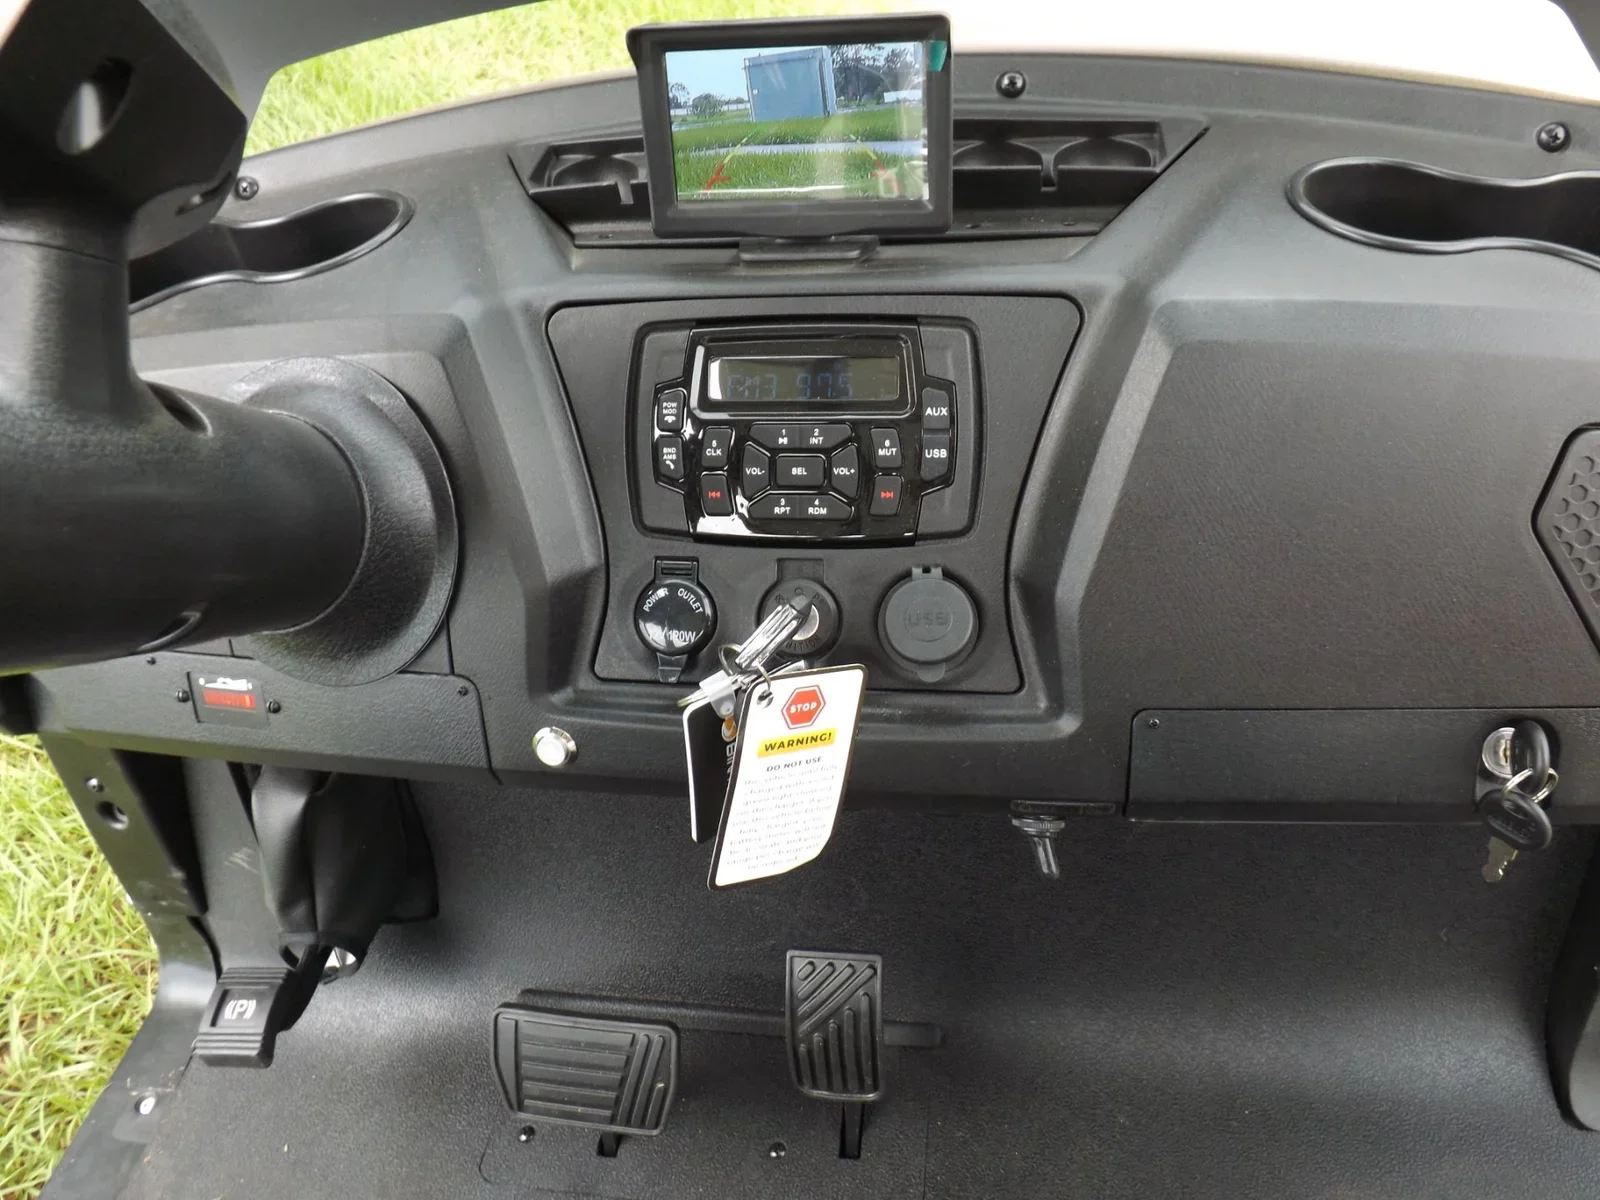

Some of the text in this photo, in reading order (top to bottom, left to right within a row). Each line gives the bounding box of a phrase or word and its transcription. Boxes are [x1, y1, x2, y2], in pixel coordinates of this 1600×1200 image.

[925, 407, 948, 416] AUX
[809, 437, 824, 445] INT
[705, 448, 722, 456] CLK
[878, 448, 897, 456] MUT
[925, 449, 947, 458] USB
[745, 467, 765, 475] VOL-
[791, 467, 808, 475] SEL
[833, 467, 855, 475] VOL+
[780, 498, 786, 506] 3
[814, 498, 820, 506] 4
[774, 506, 791, 514] RPT
[808, 506, 827, 514] RDM
[643, 587, 704, 614] POWER OUTLET
[790, 702, 817, 714] STOP
[764, 732, 832, 752] WARNING!
[766, 756, 822, 772] DO NOT USE
